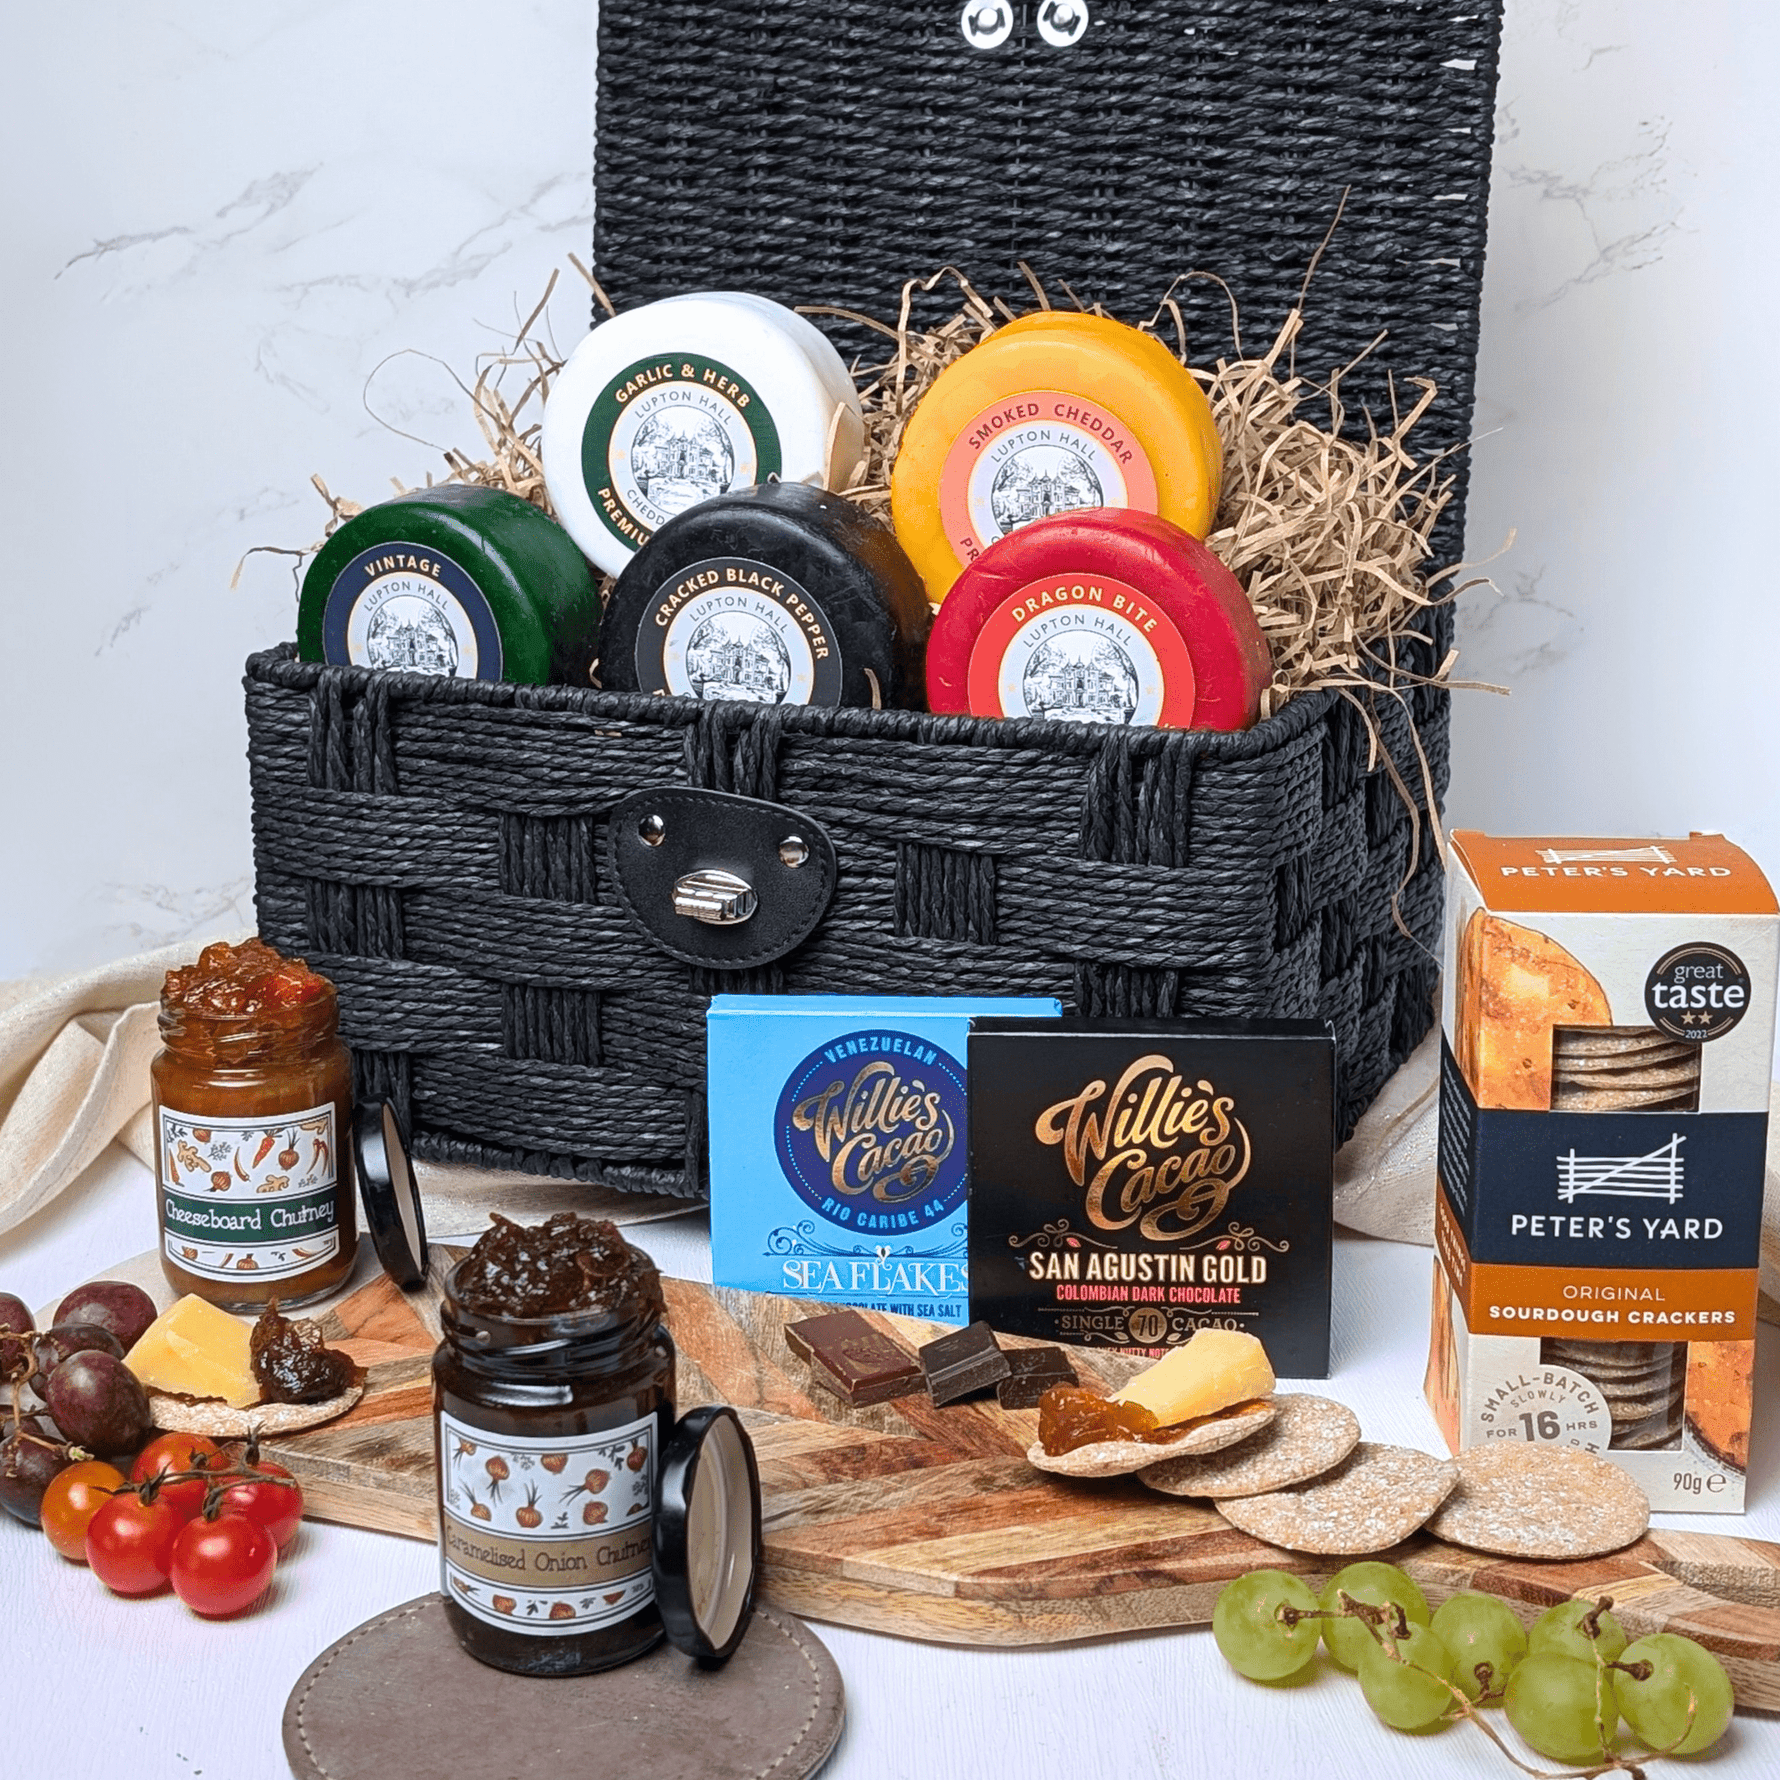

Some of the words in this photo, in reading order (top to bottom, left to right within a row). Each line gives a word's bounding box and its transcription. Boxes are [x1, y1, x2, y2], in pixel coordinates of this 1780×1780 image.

[615, 364, 673, 404] GARLIC
[680, 364, 695, 378] &
[703, 368, 751, 408] HERB
[635, 391, 692, 418] LUPTON
[699, 395, 732, 425] HALL
[969, 402, 1040, 450] SMOKED
[1054, 403, 1132, 464] CHEDDAR
[991, 430, 1051, 462] LUPTON
[1059, 432, 1096, 461] HALL
[598, 488, 650, 546] PREMIU
[626, 488, 665, 526] CHEDD
[364, 554, 442, 578] VINTAGE
[364, 581, 411, 612] LUPTON
[417, 583, 448, 611] HALL
[1011, 586, 1103, 622] DRAGON
[1113, 594, 1158, 633] BITE
[655, 569, 719, 627] CRACKED
[726, 568, 785, 597] BLACK
[786, 593, 829, 660] PEPPER
[689, 596, 747, 622] LUPTON
[755, 602, 788, 634] HALL
[1024, 614, 1085, 648] LUPTON
[1094, 617, 1132, 647] HALL
[1500, 866, 1629, 877] PETER'S
[1640, 866, 1732, 877] YARD
[1674, 963, 1724, 984] great
[1651, 981, 1745, 1009] taste
[1685, 1029, 1708, 1039] 2022
[824, 1036, 938, 1066] VENEZUELAN
[832, 1128, 954, 1203] Cacao
[1085, 1144, 1251, 1241] Cacao
[166, 1198, 262, 1230] Cheeseboard
[270, 1200, 335, 1228] Chutney
[821, 1197, 852, 1221] RIO
[857, 1210, 919, 1229] CARIBE
[924, 1199, 944, 1218] 44
[1511, 1214, 1631, 1239] PETER'S
[1642, 1217, 1723, 1240] YARD
[782, 1260, 845, 1293] SEA
[1029, 1251, 1081, 1281] SAN
[1085, 1252, 1195, 1283] AGUSTIN
[1202, 1254, 1267, 1284] GOLD
[1056, 1284, 1129, 1302] COLOMBIAN
[1132, 1286, 1165, 1302] DARK
[1169, 1287, 1241, 1304] CHOCOLATE
[1563, 1285, 1665, 1302] ORIGINAL
[917, 1303, 937, 1318] SEA
[938, 1304, 962, 1318] SALT
[1061, 1315, 1125, 1331] SINGLE
[1137, 1315, 1158, 1337] 70
[1489, 1306, 1619, 1324] SOURDOUGH
[1628, 1310, 1735, 1325] CRACKERS
[1480, 1372, 1600, 1423] SMALL-BATCH
[1510, 1389, 1566, 1410] SLOWLY
[1486, 1427, 1518, 1439] FOR
[1519, 1410, 1561, 1441] 16
[1566, 1420, 1599, 1432] HRS
[535, 1551, 588, 1572] Onion
